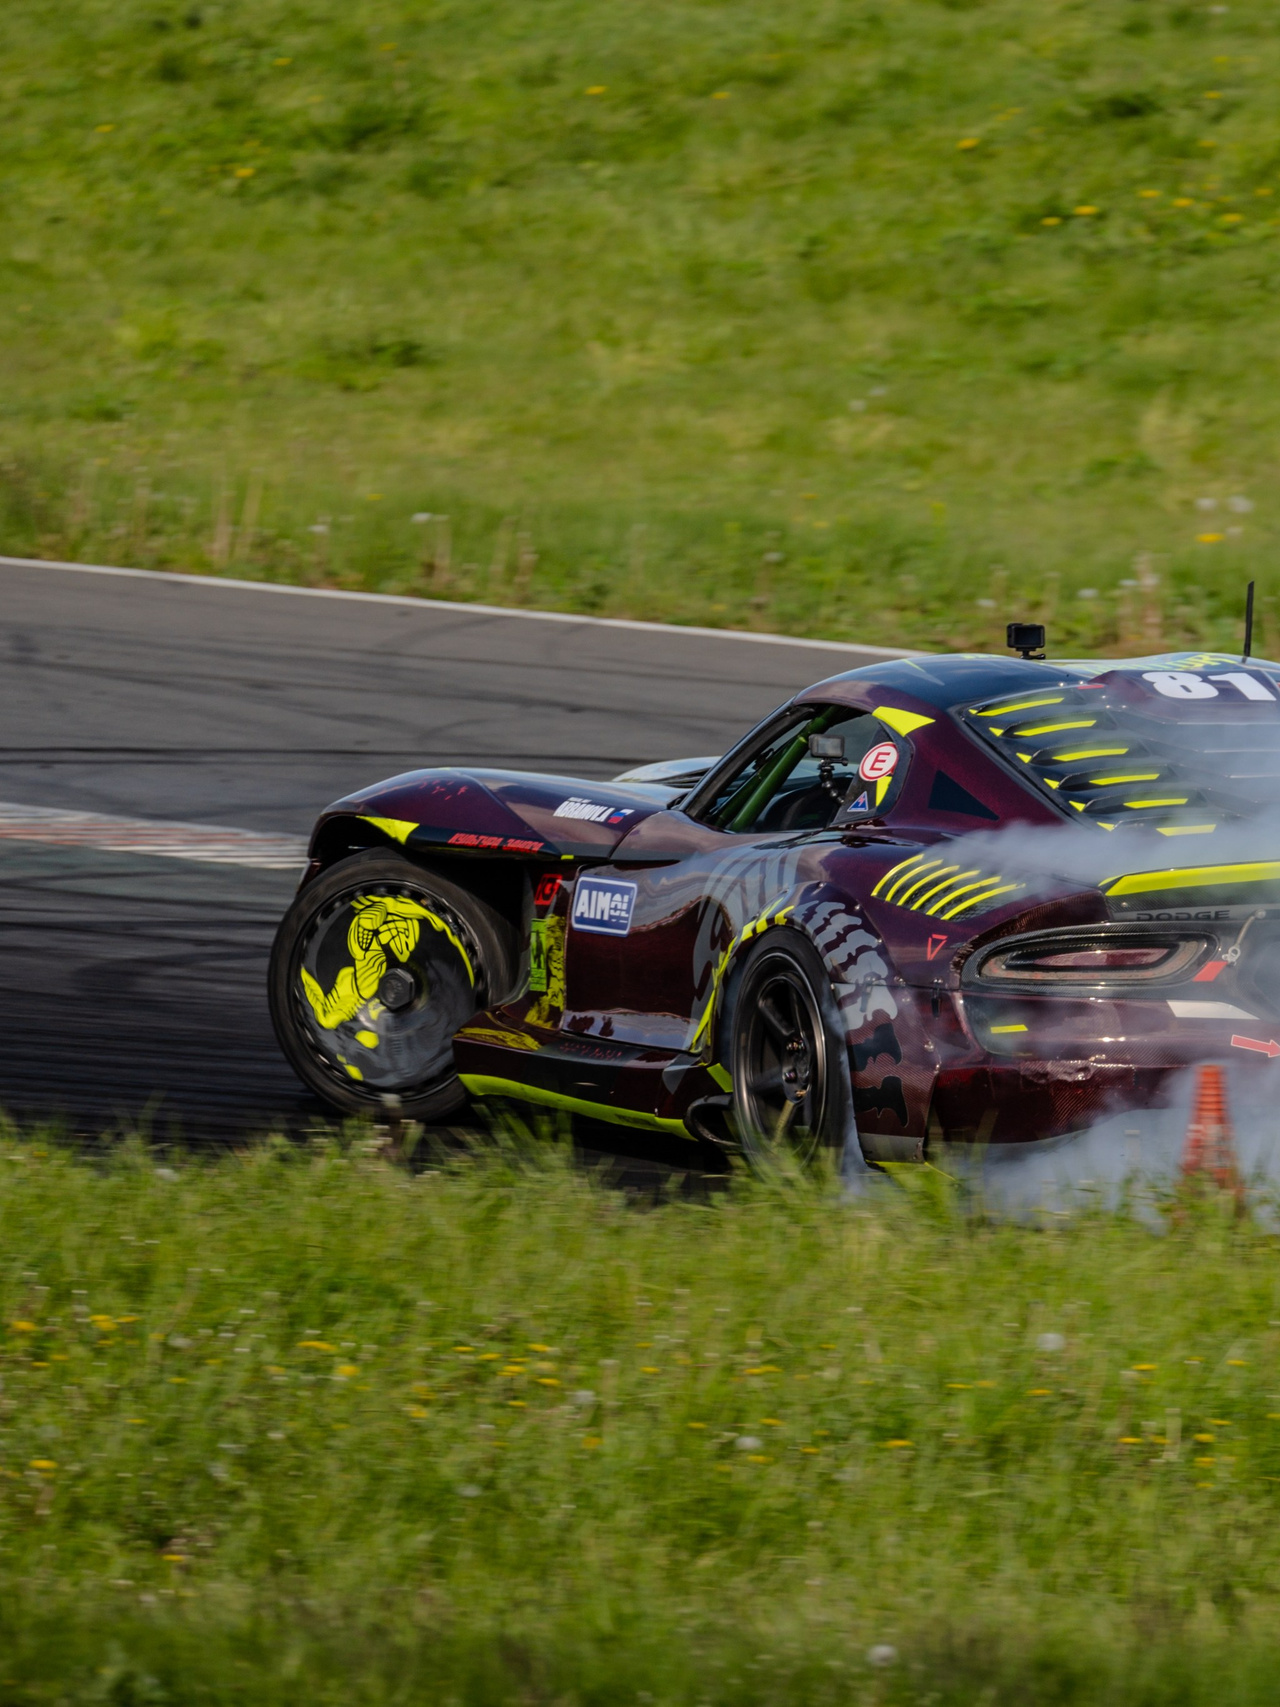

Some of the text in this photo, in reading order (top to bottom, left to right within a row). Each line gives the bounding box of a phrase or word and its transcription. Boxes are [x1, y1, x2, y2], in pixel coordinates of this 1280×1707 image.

[1142, 672, 1277, 701] 81
[868, 751, 891, 771] E
[575, 889, 630, 922] AIMOL
[1136, 909, 1230, 921] DODGE
